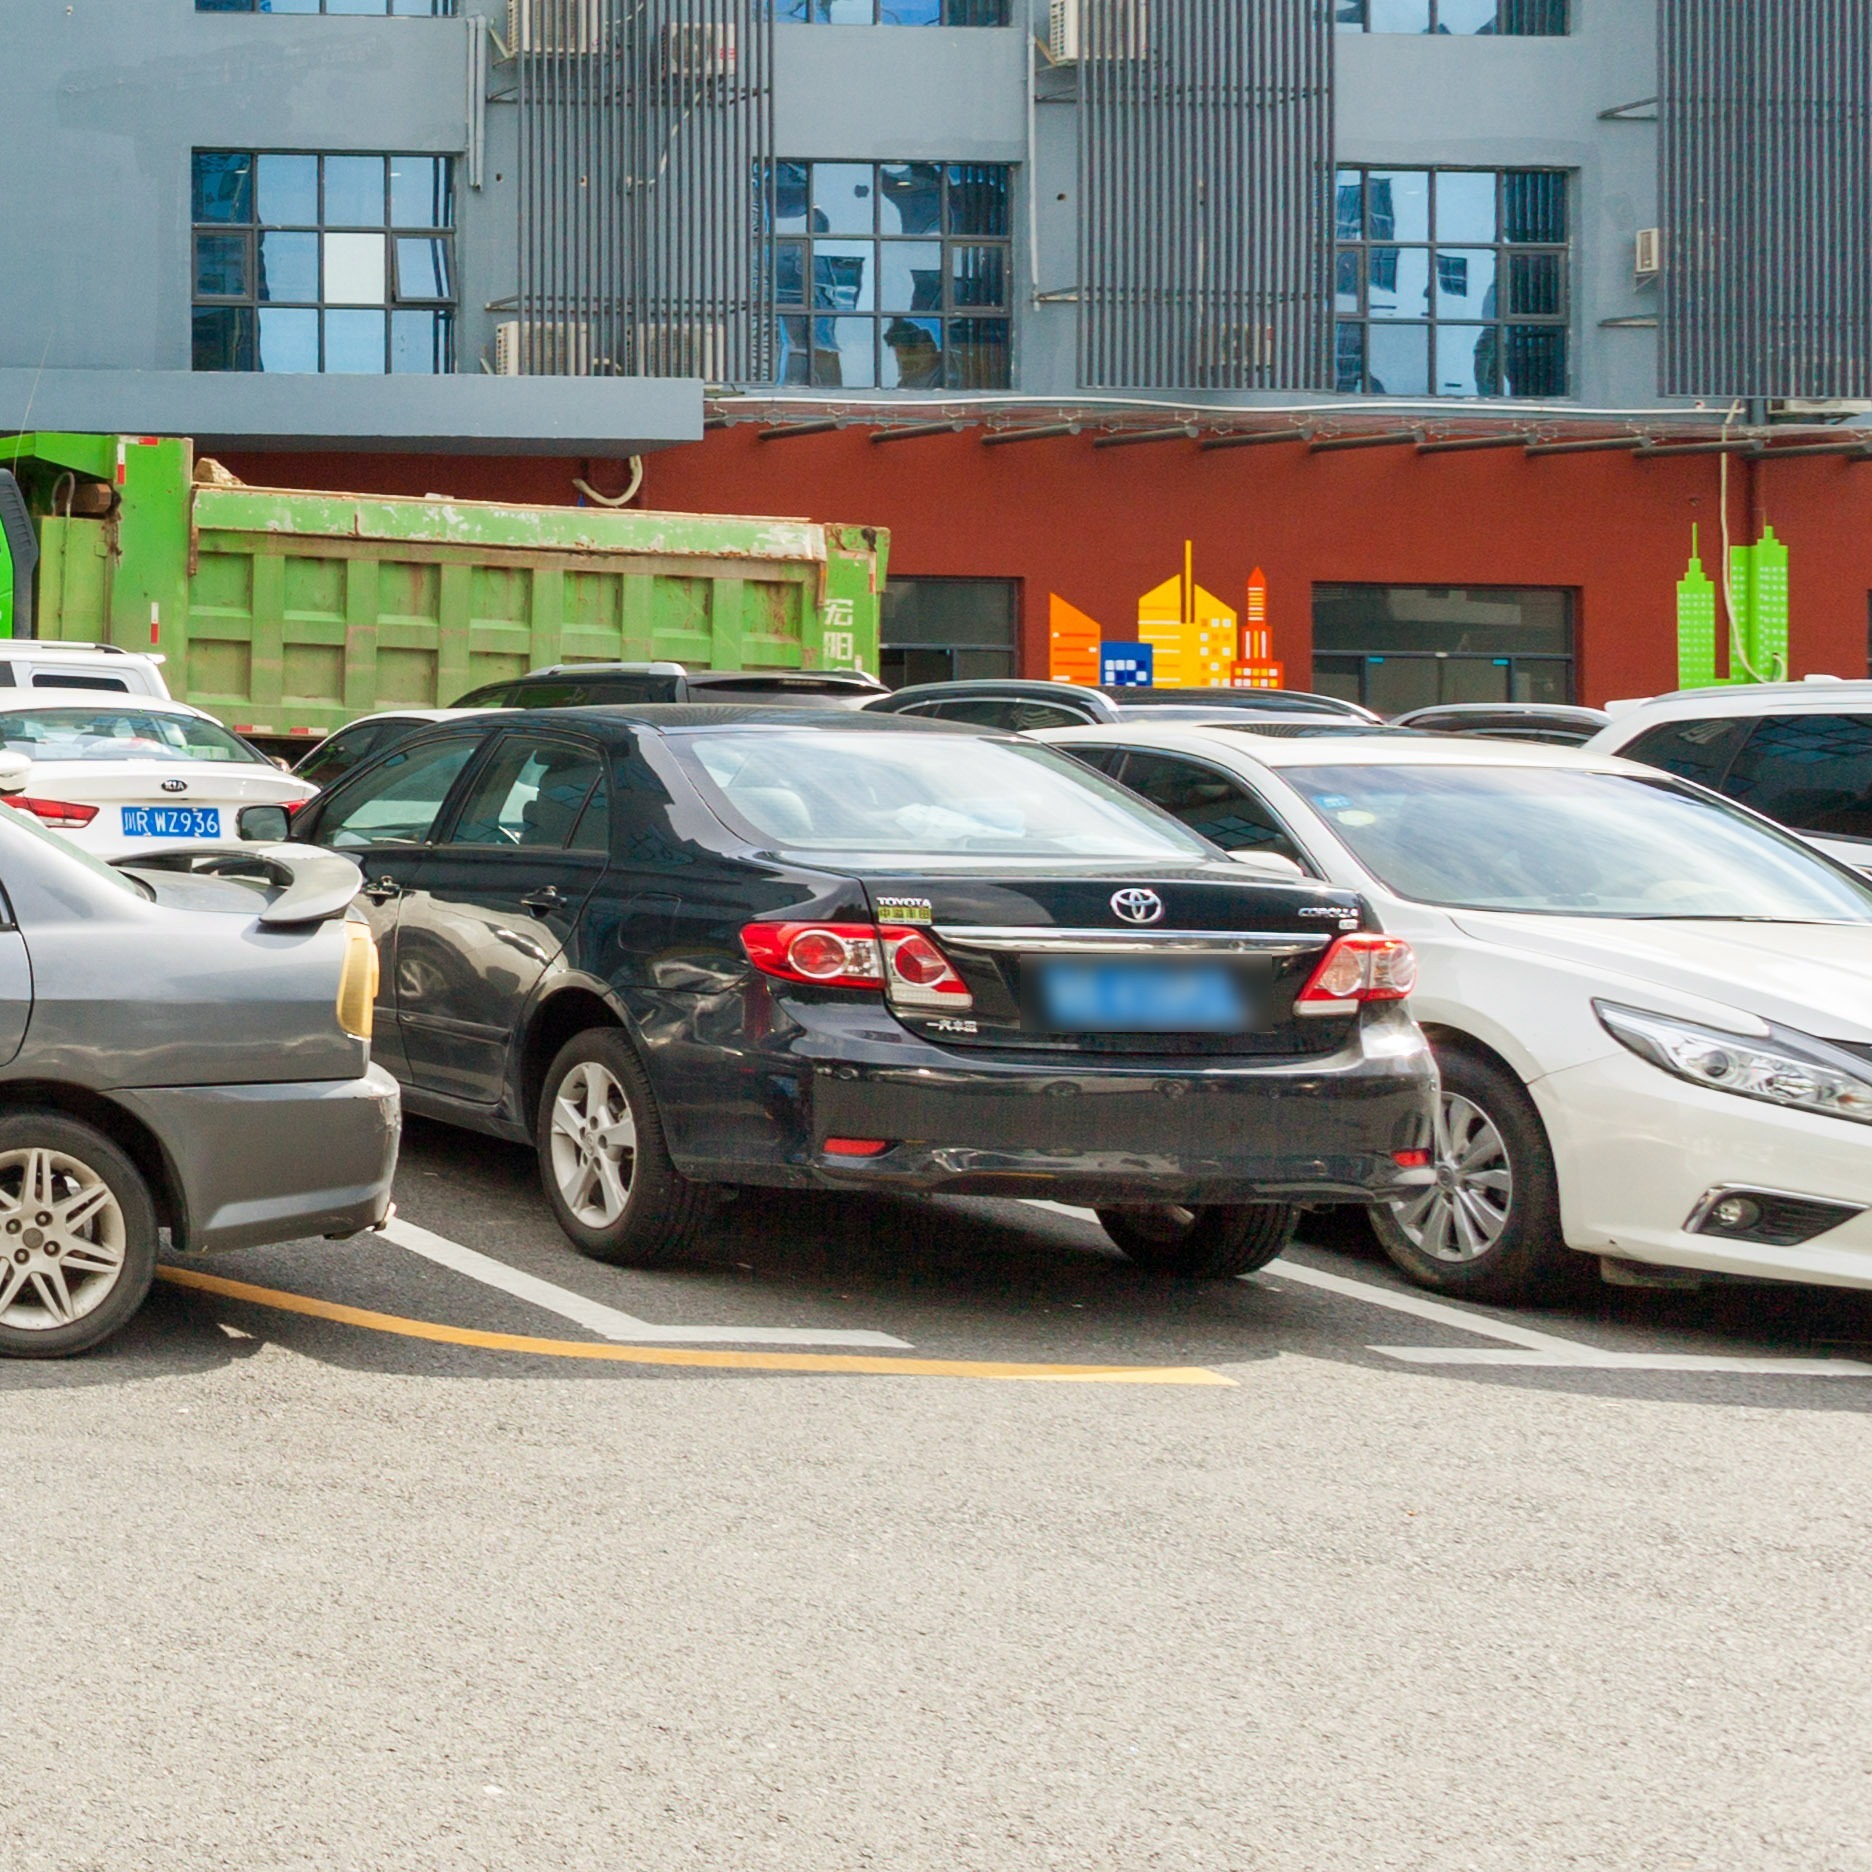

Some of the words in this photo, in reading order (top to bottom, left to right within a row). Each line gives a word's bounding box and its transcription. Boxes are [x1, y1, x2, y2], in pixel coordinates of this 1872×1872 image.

[823, 598, 854, 671] 宏阳
[164, 781, 185, 791] KIA
[876, 897, 932, 908] TOYOTA
